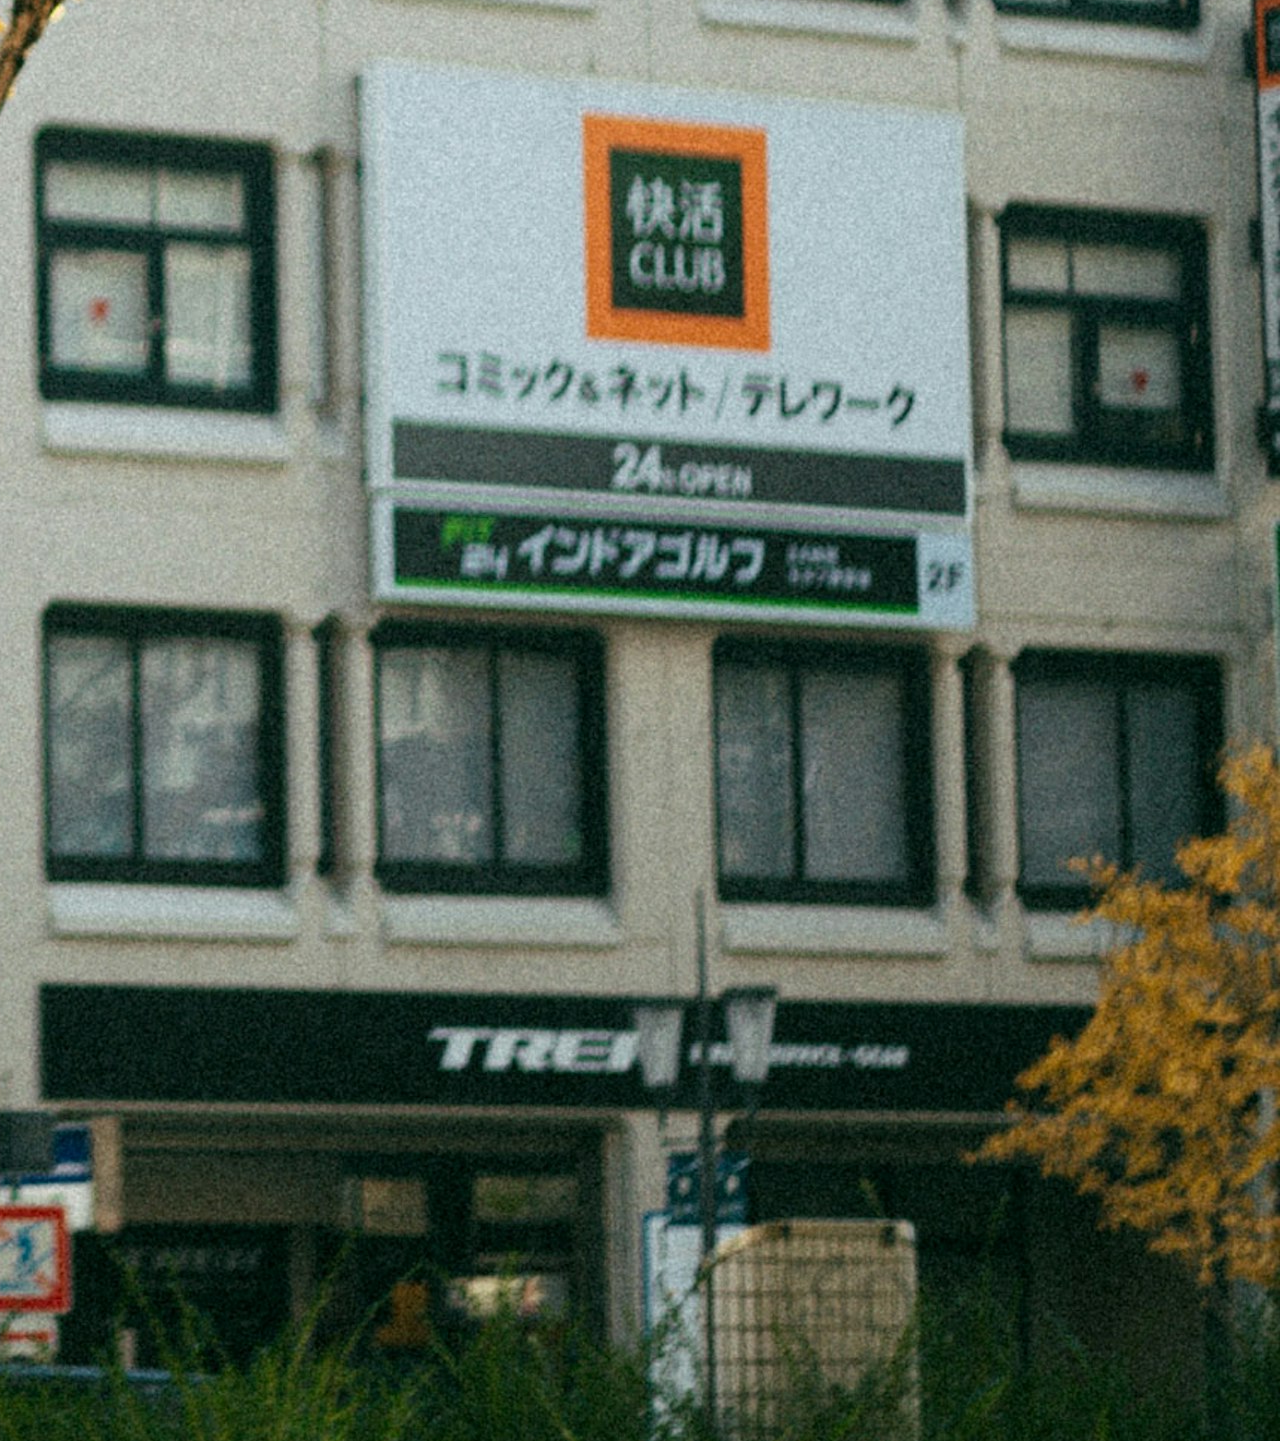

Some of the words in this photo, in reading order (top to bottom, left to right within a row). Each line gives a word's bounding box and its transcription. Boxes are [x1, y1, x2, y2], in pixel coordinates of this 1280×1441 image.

[626, 176, 725, 243] 快活
[628, 241, 726, 293] CLUB
[741, 373, 917, 426] テレワーク
[678, 461, 753, 497] OPEN
[517, 524, 765, 585] インドアゴルフ
[926, 560, 964, 593] 2F
[431, 1027, 638, 1072] TRE
